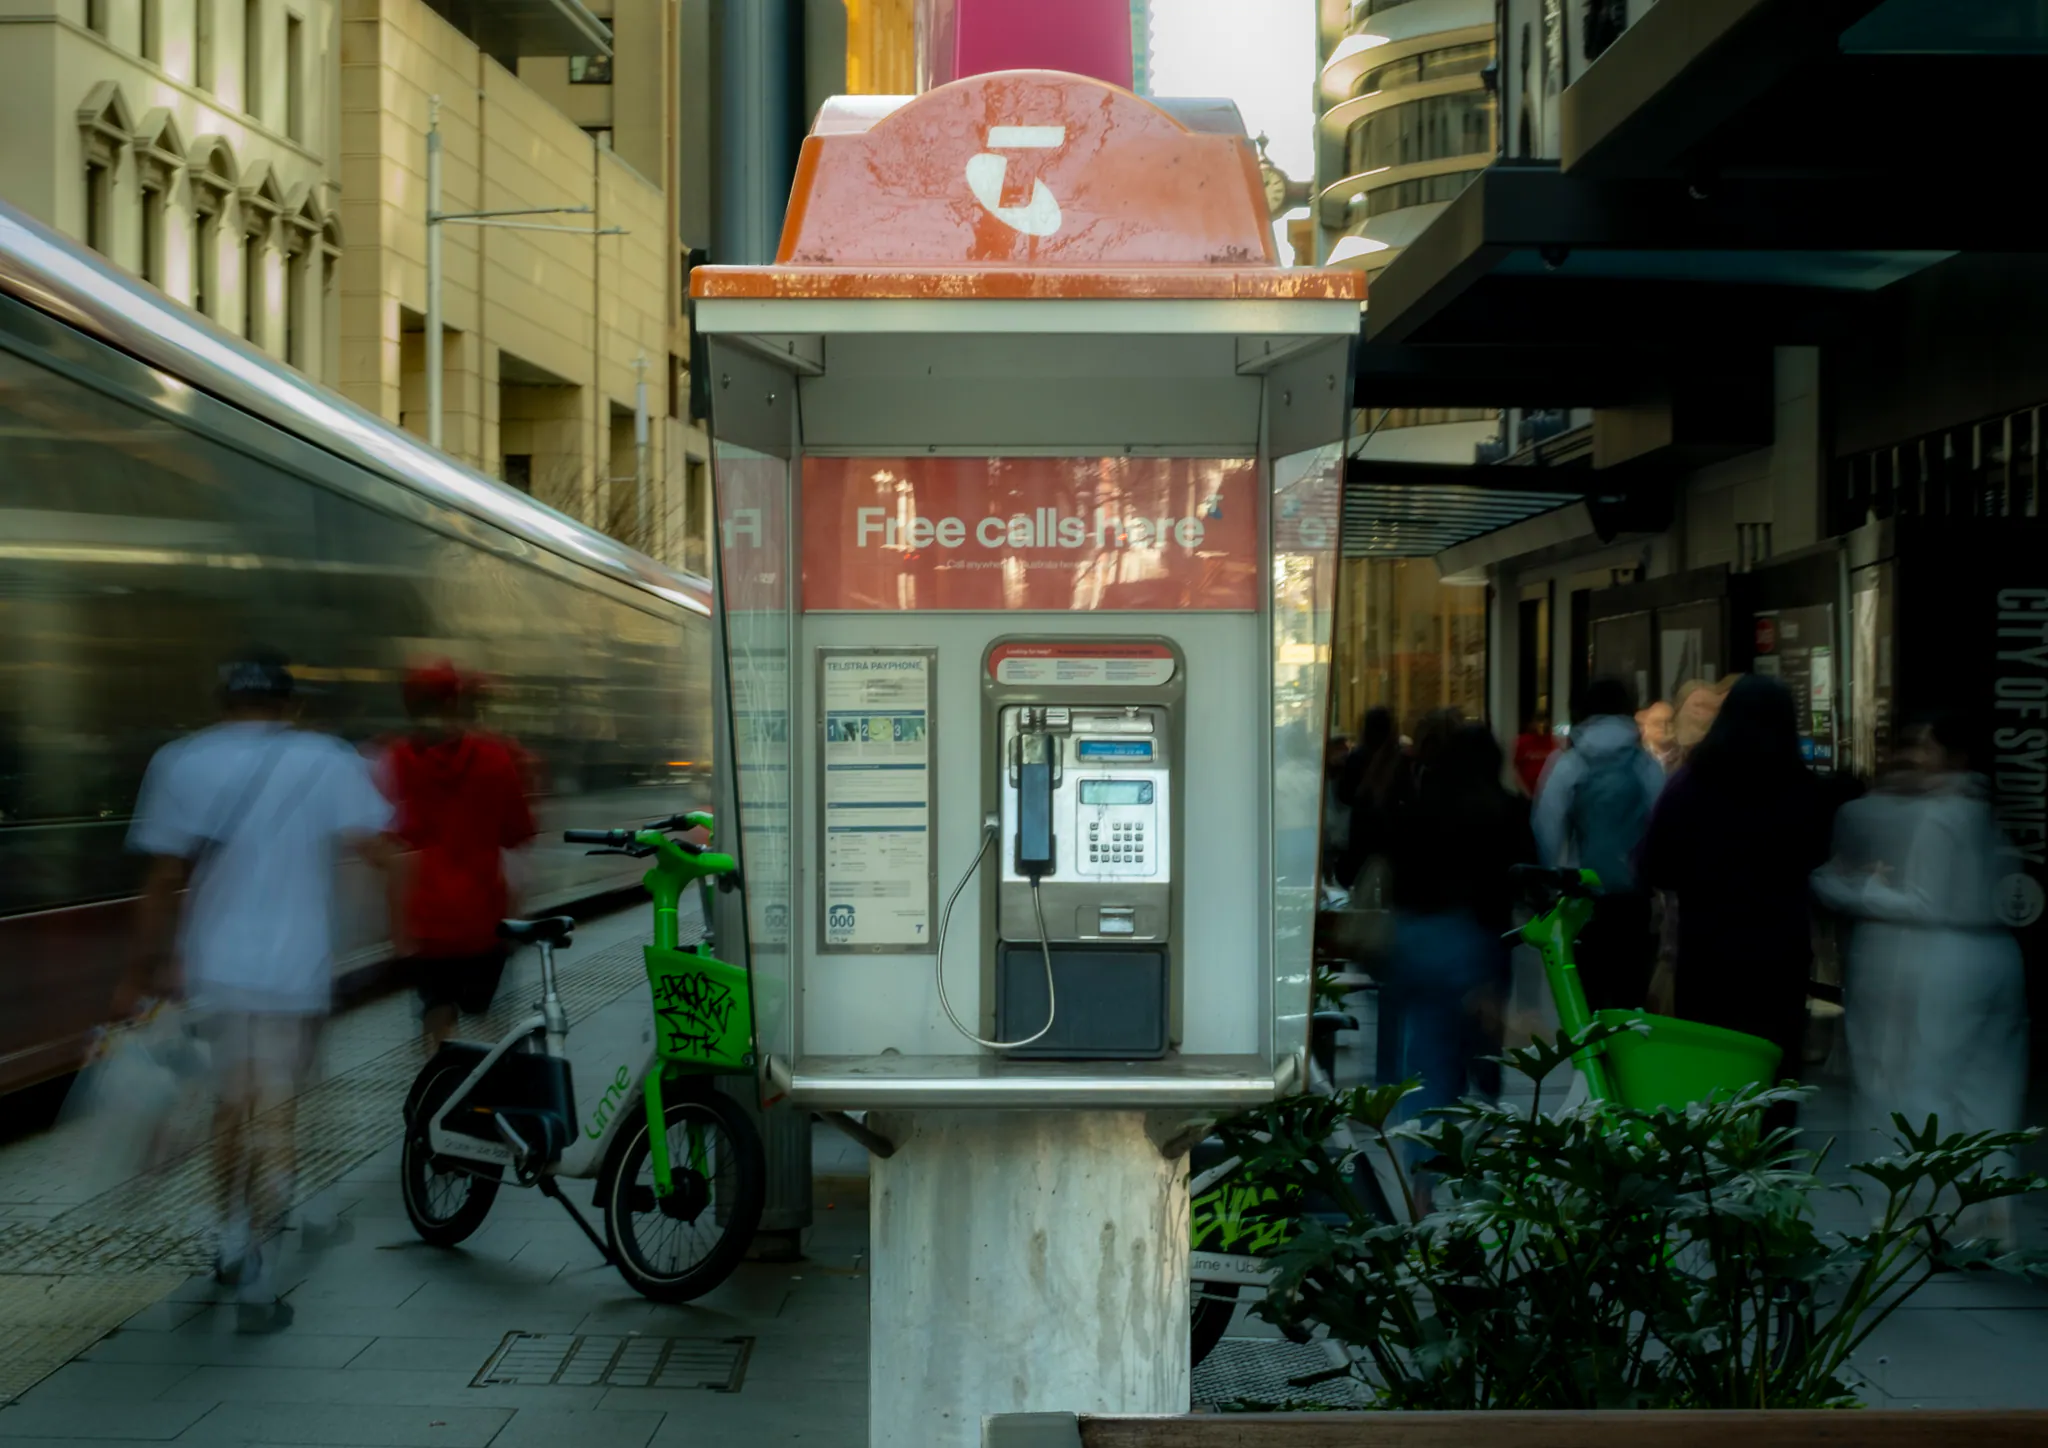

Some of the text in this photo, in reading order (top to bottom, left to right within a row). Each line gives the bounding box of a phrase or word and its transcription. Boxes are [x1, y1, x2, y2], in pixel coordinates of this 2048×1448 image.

[857, 506, 1205, 548] Free calls here
[827, 661, 921, 670] TELSTRA PAYPHONE
[829, 724, 835, 737] 1
[861, 724, 869, 737] 2
[894, 724, 902, 737] 3
[1993, 588, 2048, 865] CITY OF SYDNEY
[829, 914, 855, 928] 000
